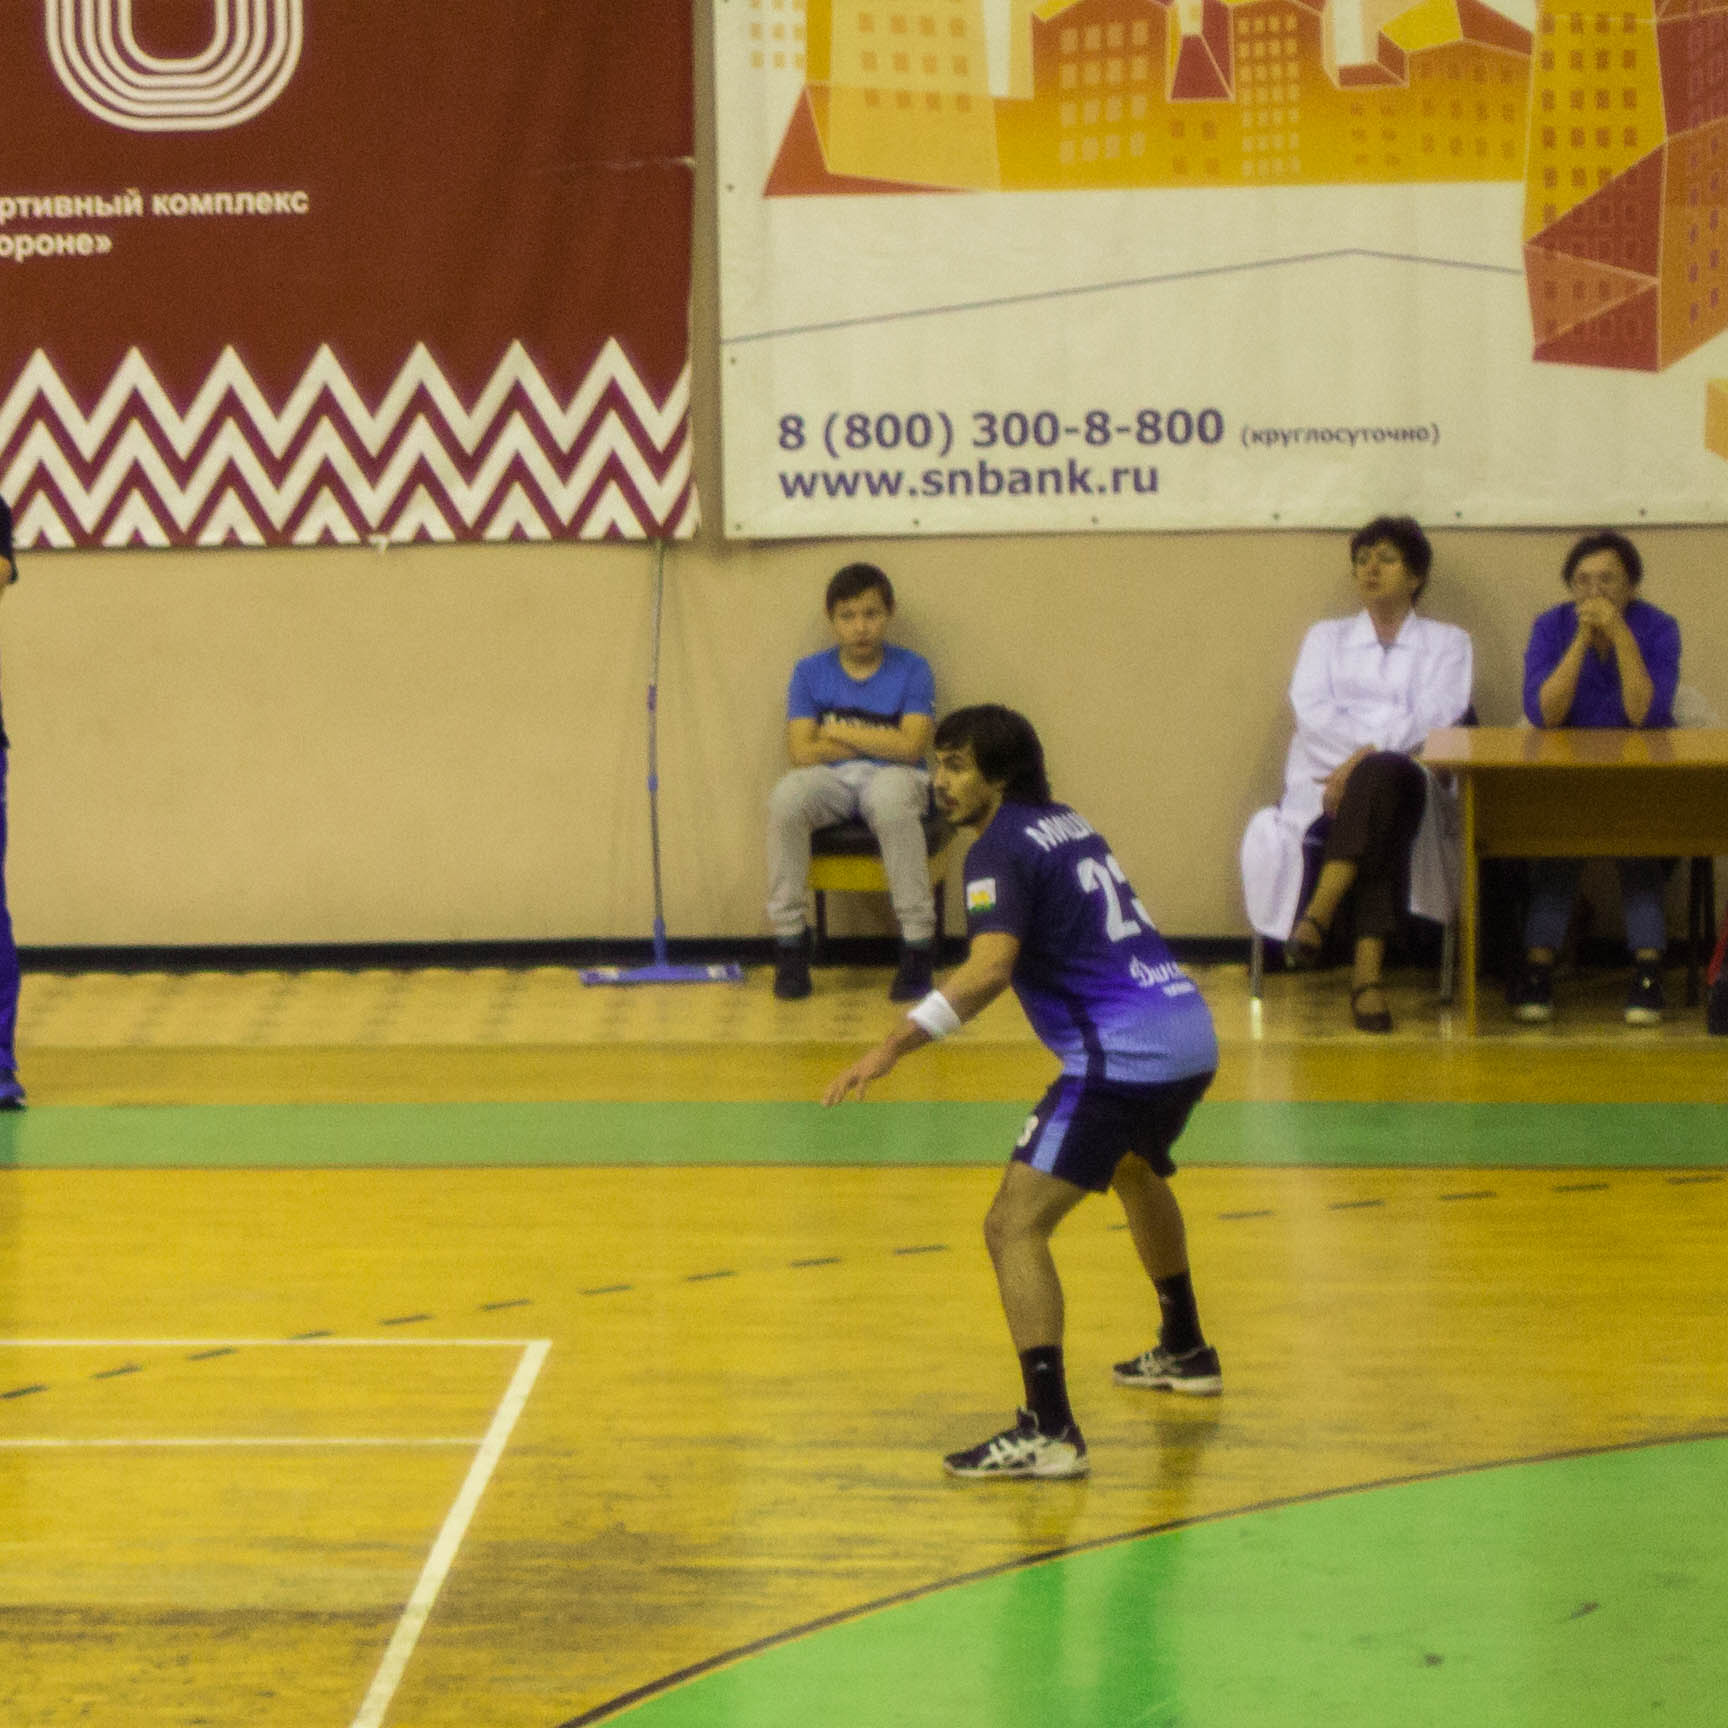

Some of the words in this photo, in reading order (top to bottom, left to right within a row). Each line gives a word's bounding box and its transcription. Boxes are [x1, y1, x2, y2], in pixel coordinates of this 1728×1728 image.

[151, 190, 310, 217] комплекс
[778, 413, 806, 450] 8
[822, 410, 954, 459] (800)
[972, 407, 1225, 449] 300-8-800
[1241, 422, 1440, 449] (круглосуточно)
[778, 456, 1158, 499] www.snbank.ru
